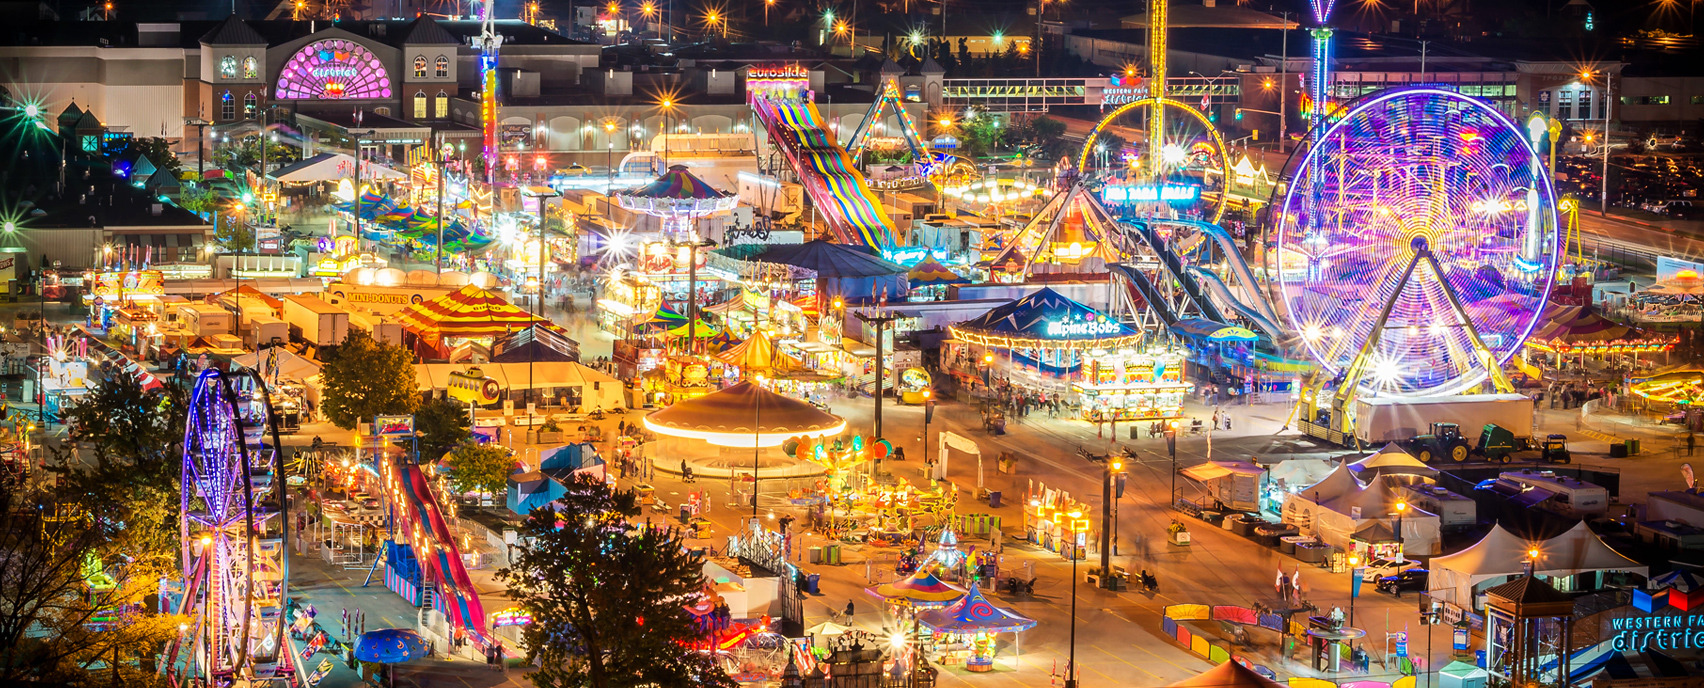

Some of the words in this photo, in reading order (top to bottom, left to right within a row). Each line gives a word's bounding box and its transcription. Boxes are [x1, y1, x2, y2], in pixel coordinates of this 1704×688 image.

[313, 68, 358, 78] district
[347, 292, 408, 304] MINI-DONUTS
[1612, 616, 1682, 630] WESTERN
